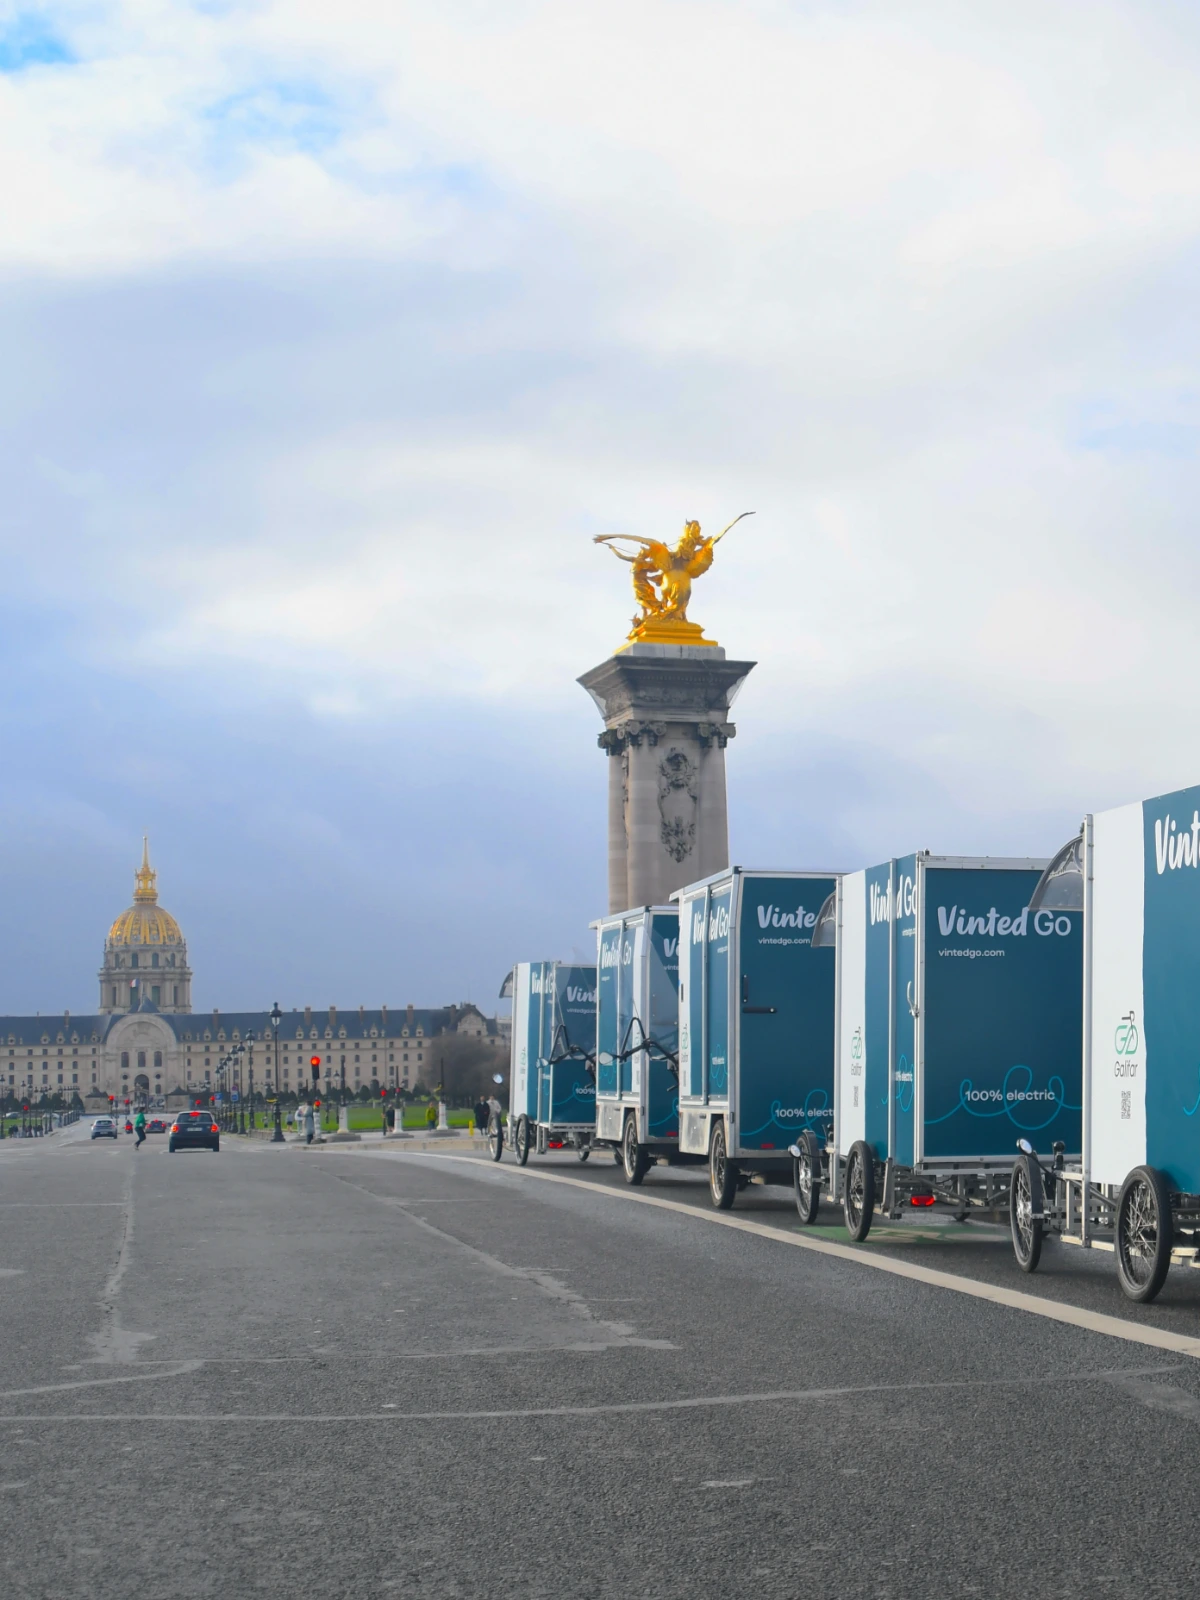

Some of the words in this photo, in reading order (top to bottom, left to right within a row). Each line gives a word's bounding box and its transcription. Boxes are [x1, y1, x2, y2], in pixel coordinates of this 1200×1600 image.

[757, 905, 818, 929] Vinte
[938, 905, 1029, 937] Vinted
[1034, 909, 1071, 936] Go
[758, 937, 811, 945] vintedgo.com
[939, 948, 1005, 959] vintedgo.com
[1114, 1060, 1138, 1077] Galifar
[965, 1089, 1003, 1102] 100%
[1006, 1089, 1055, 1101] electric
[775, 1108, 805, 1118] 100%
